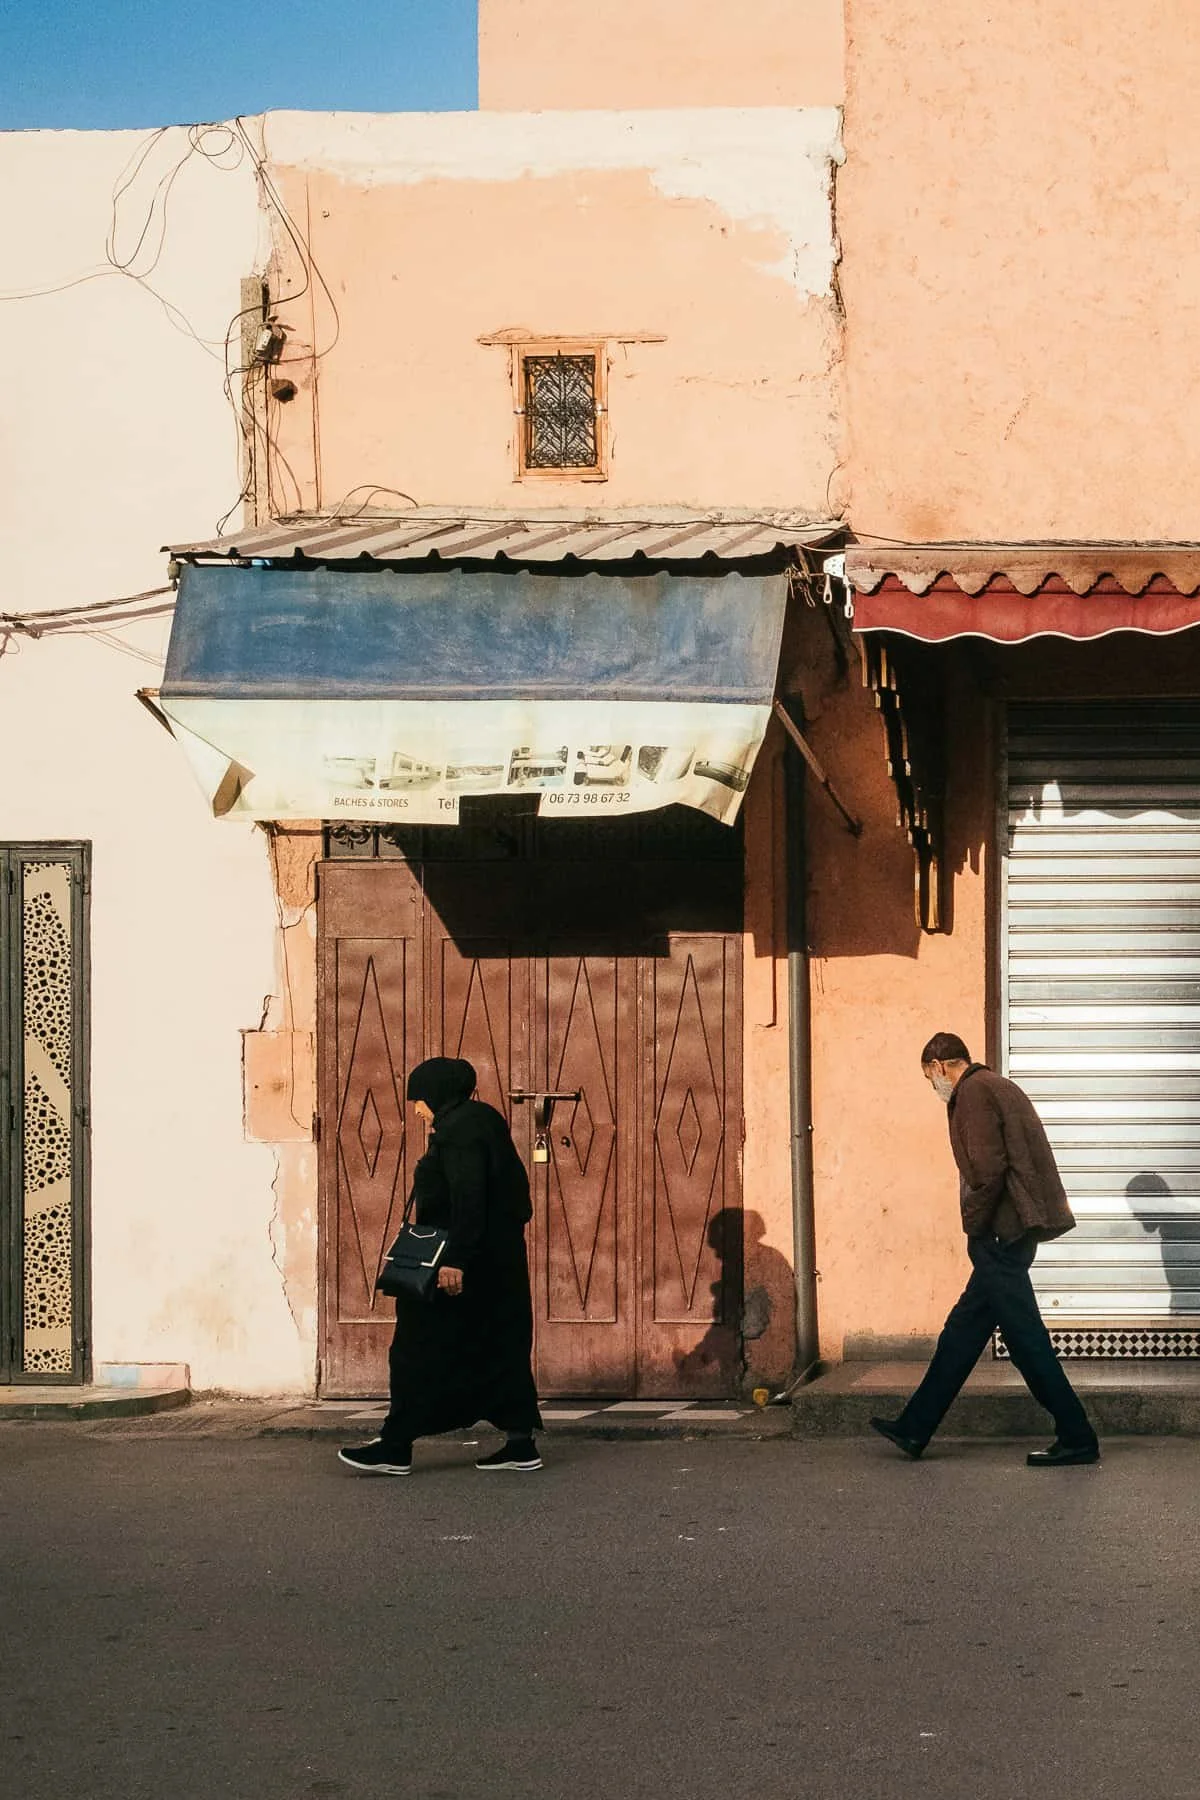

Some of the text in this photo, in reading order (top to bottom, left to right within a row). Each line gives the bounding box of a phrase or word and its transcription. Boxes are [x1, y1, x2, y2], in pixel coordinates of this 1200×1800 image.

[377, 798, 409, 808] STORES
[549, 793, 564, 804] 06
[567, 793, 580, 804] 73
[583, 793, 598, 804] 98
[600, 793, 615, 804] 67
[616, 792, 631, 803] 32
